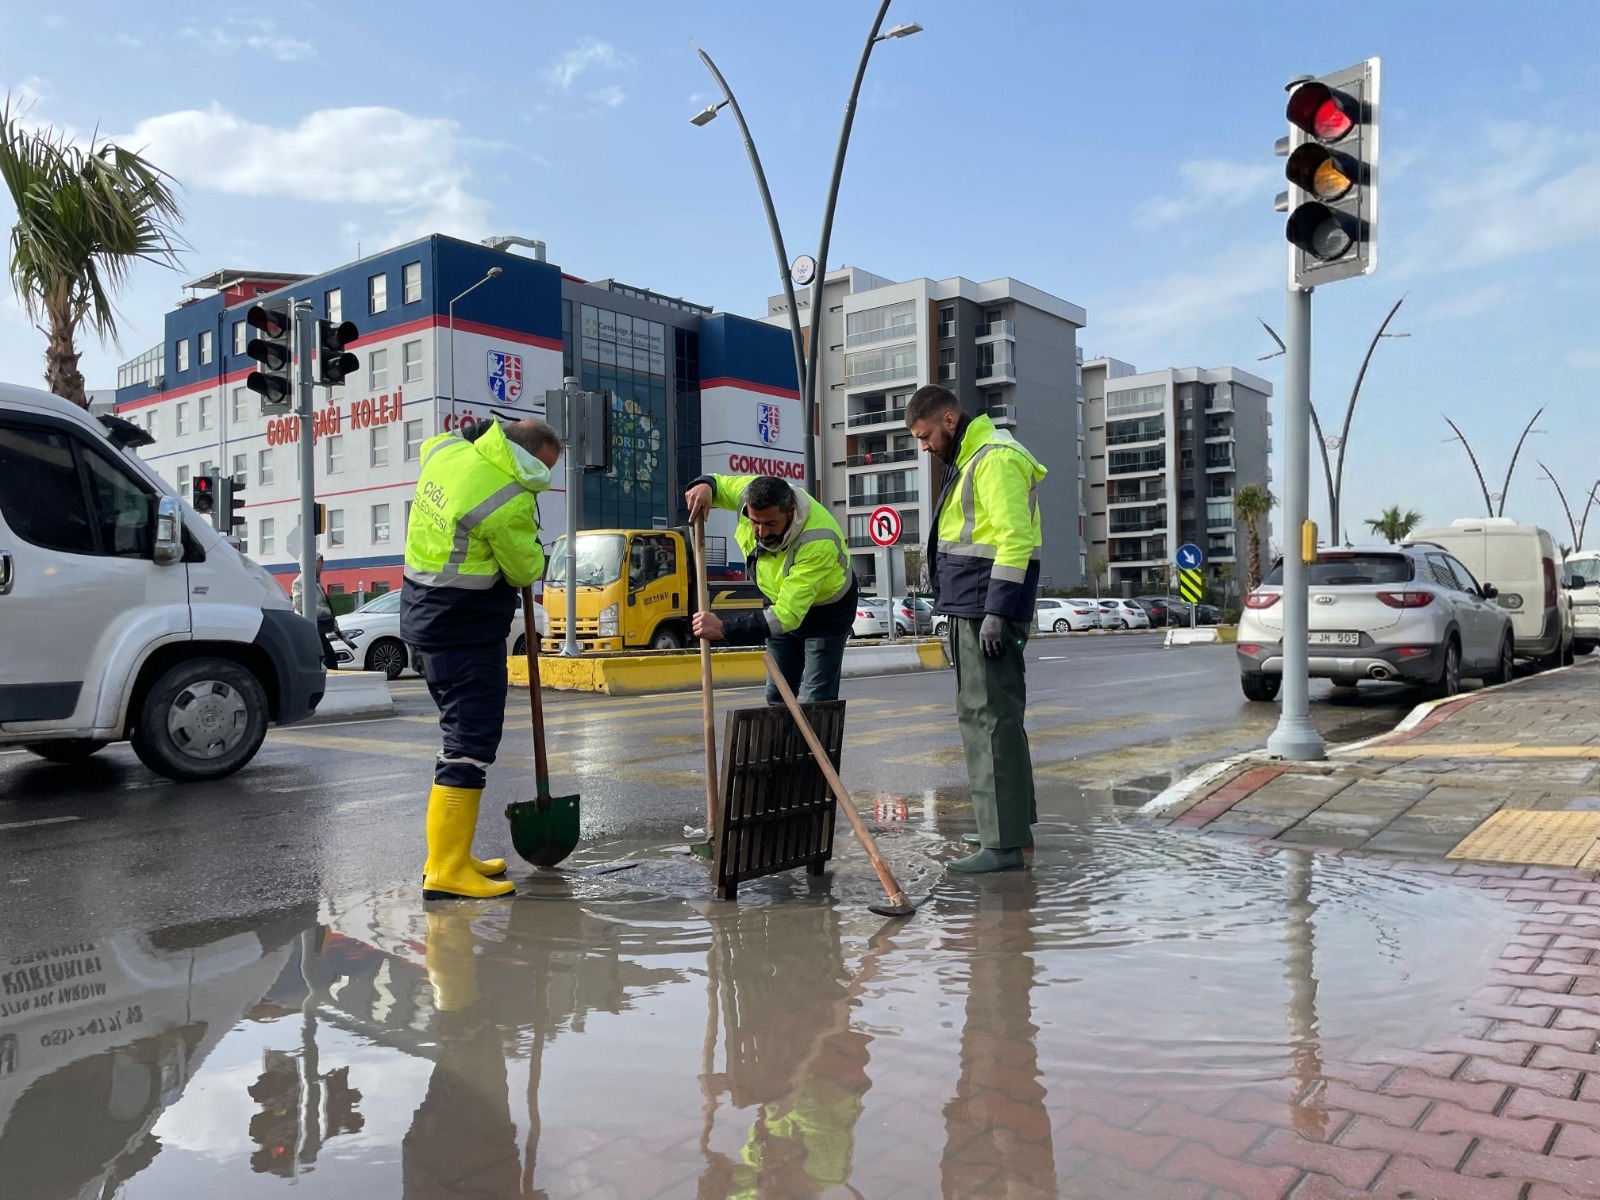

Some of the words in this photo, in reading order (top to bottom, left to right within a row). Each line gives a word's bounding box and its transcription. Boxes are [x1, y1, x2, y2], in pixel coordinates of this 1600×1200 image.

[598, 322, 628, 336] Cambidge
[585, 343, 614, 356] Camridge
[633, 339, 660, 351] Educaion
[267, 400, 341, 447] GÖKKŞAĞI
[351, 385, 403, 430] KOLEJİ
[414, 491, 448, 532] ELEDİYESİ
[1337, 633, 1358, 643] 505
